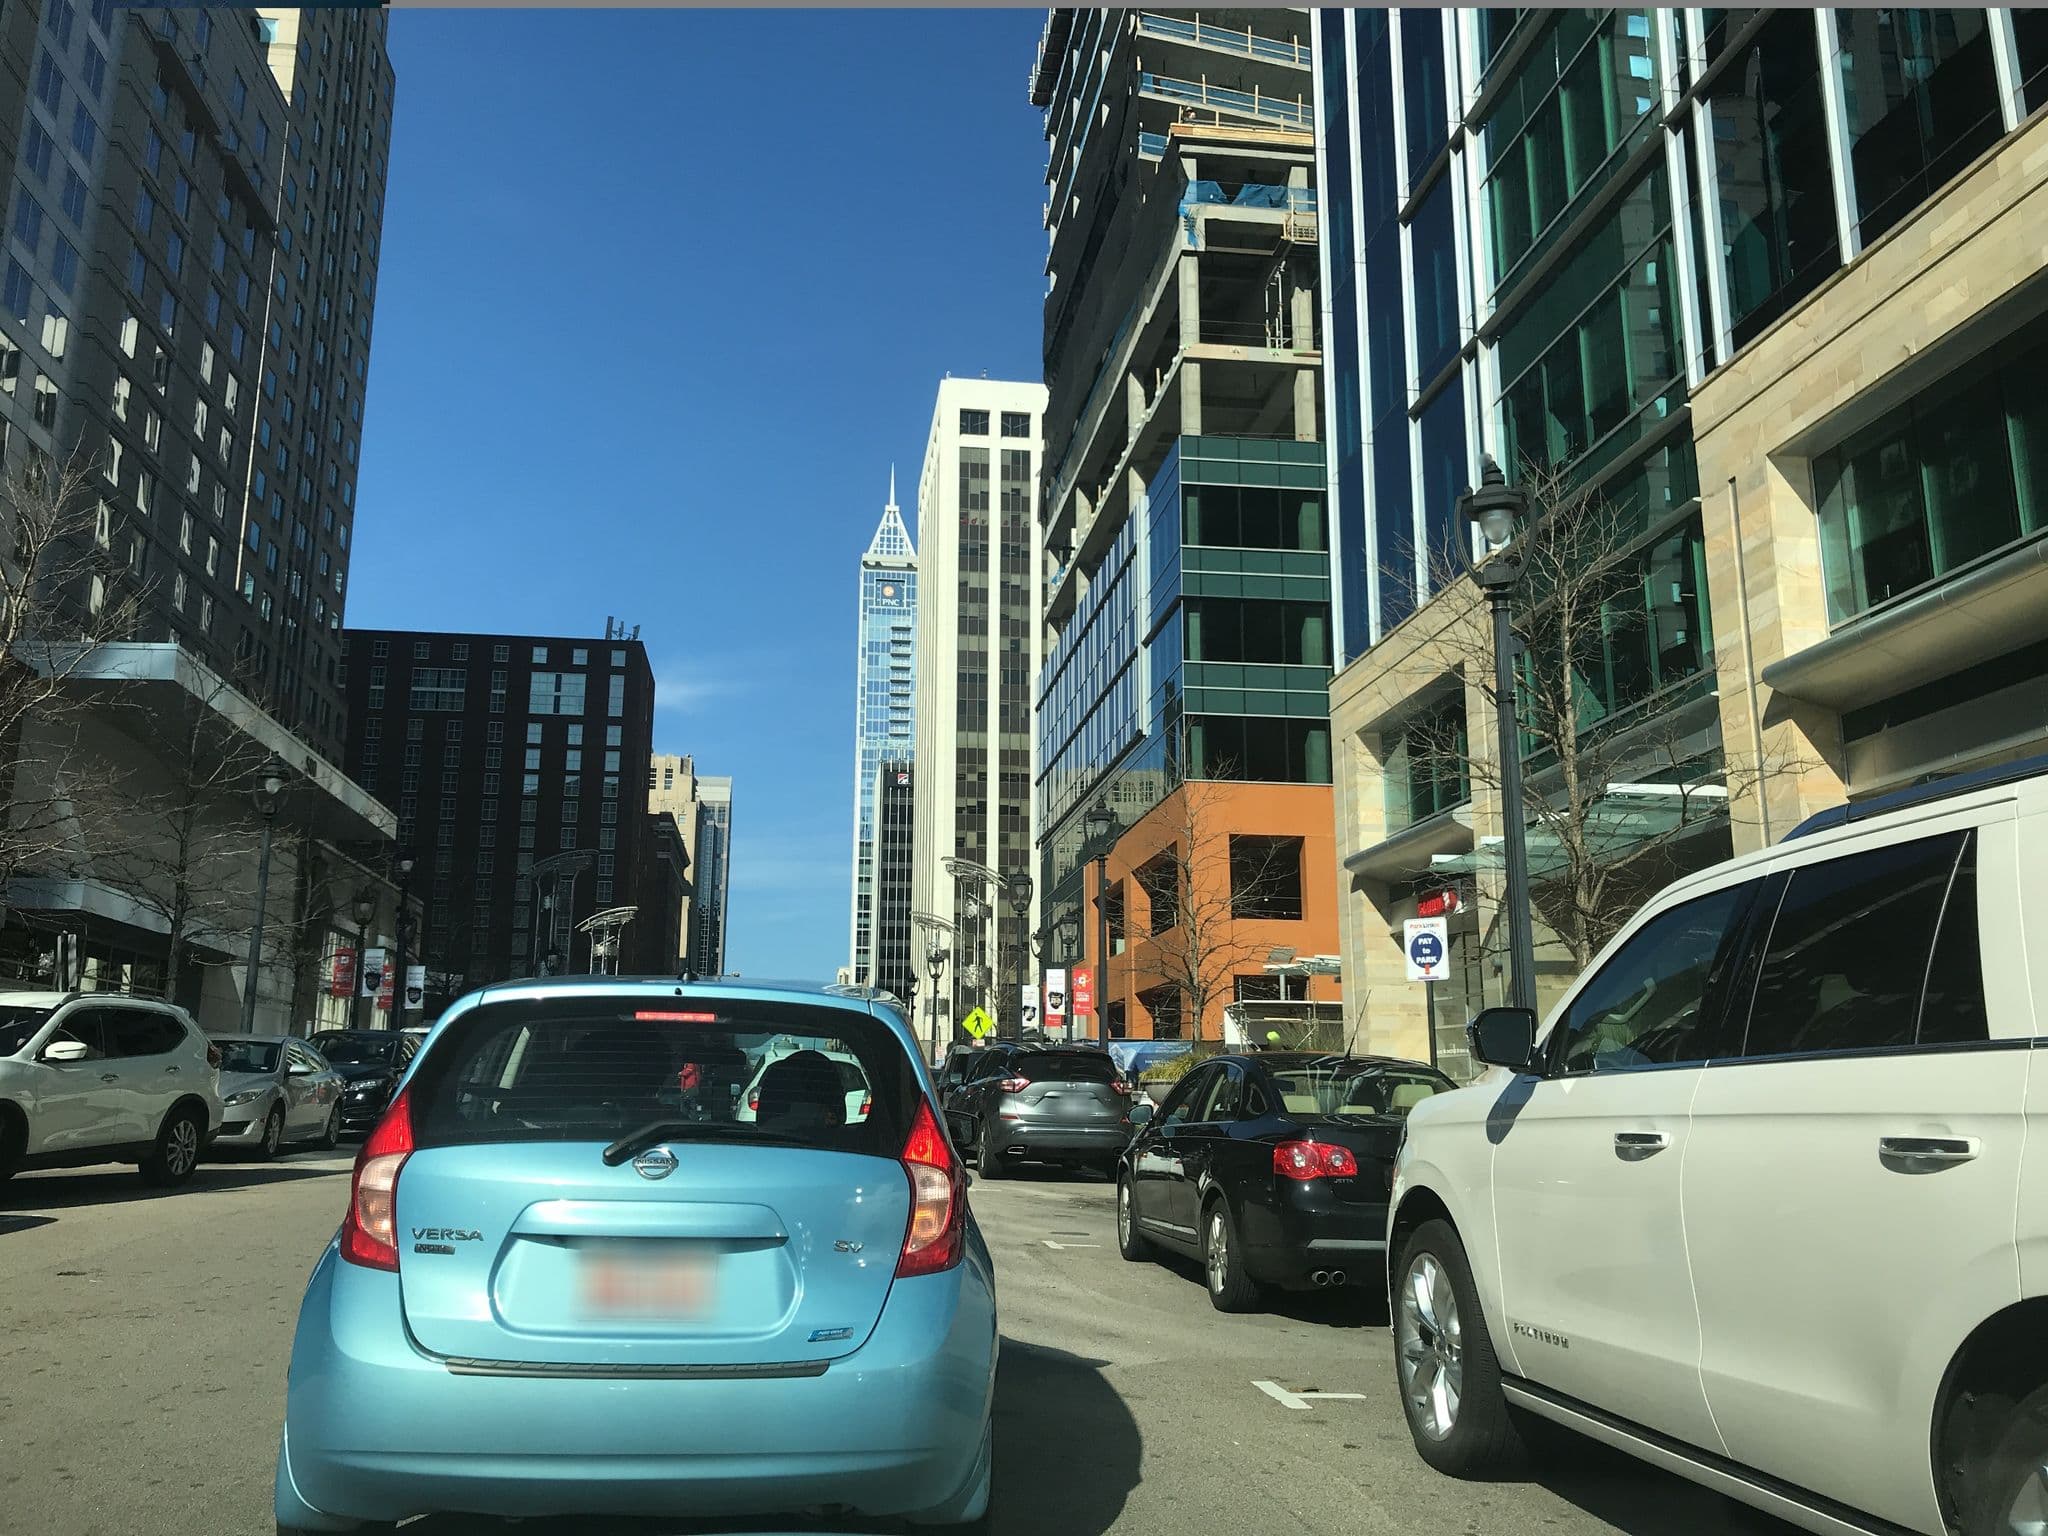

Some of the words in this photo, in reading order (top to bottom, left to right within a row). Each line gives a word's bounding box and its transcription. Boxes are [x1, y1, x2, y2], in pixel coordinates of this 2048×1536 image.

[882, 598, 900, 606] PNC
[1418, 937, 1433, 946] PAY
[1416, 956, 1438, 965] PARK
[411, 1227, 484, 1241] VERSA
[833, 1239, 864, 1254] SV
[1513, 1322, 1569, 1349] PLATINUM
